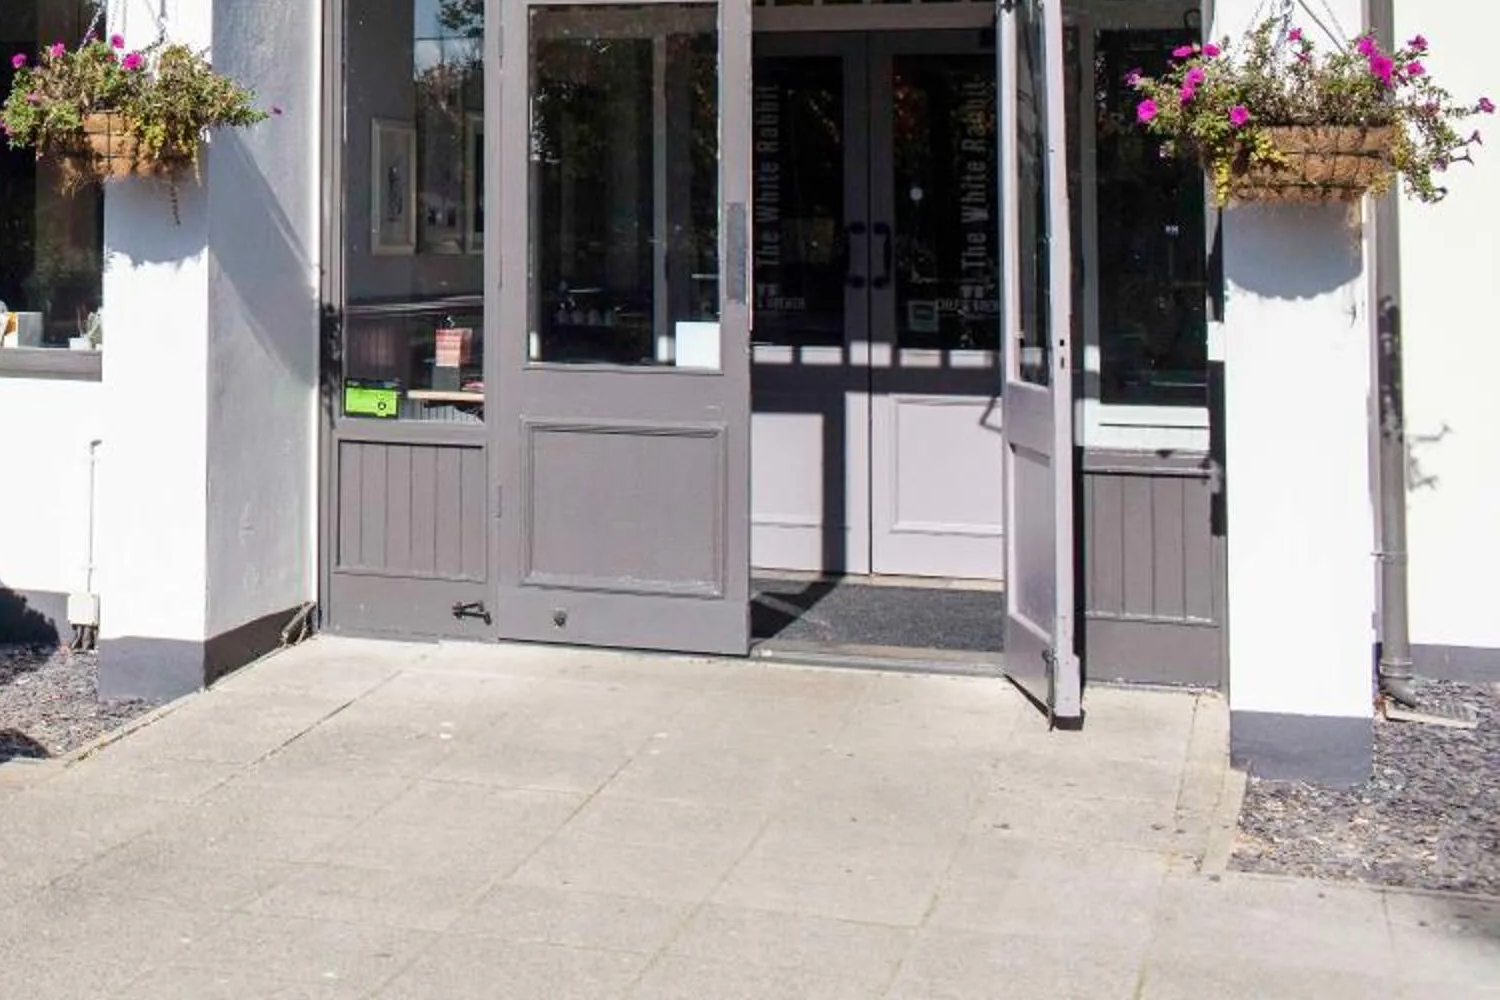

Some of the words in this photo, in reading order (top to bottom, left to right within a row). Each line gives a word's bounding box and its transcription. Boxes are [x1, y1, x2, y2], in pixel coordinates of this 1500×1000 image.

[756, 83, 781, 153] Rabbit
[756, 160, 781, 223] White
[960, 159, 989, 224] White
[756, 230, 780, 268] The
[961, 231, 988, 271] The
